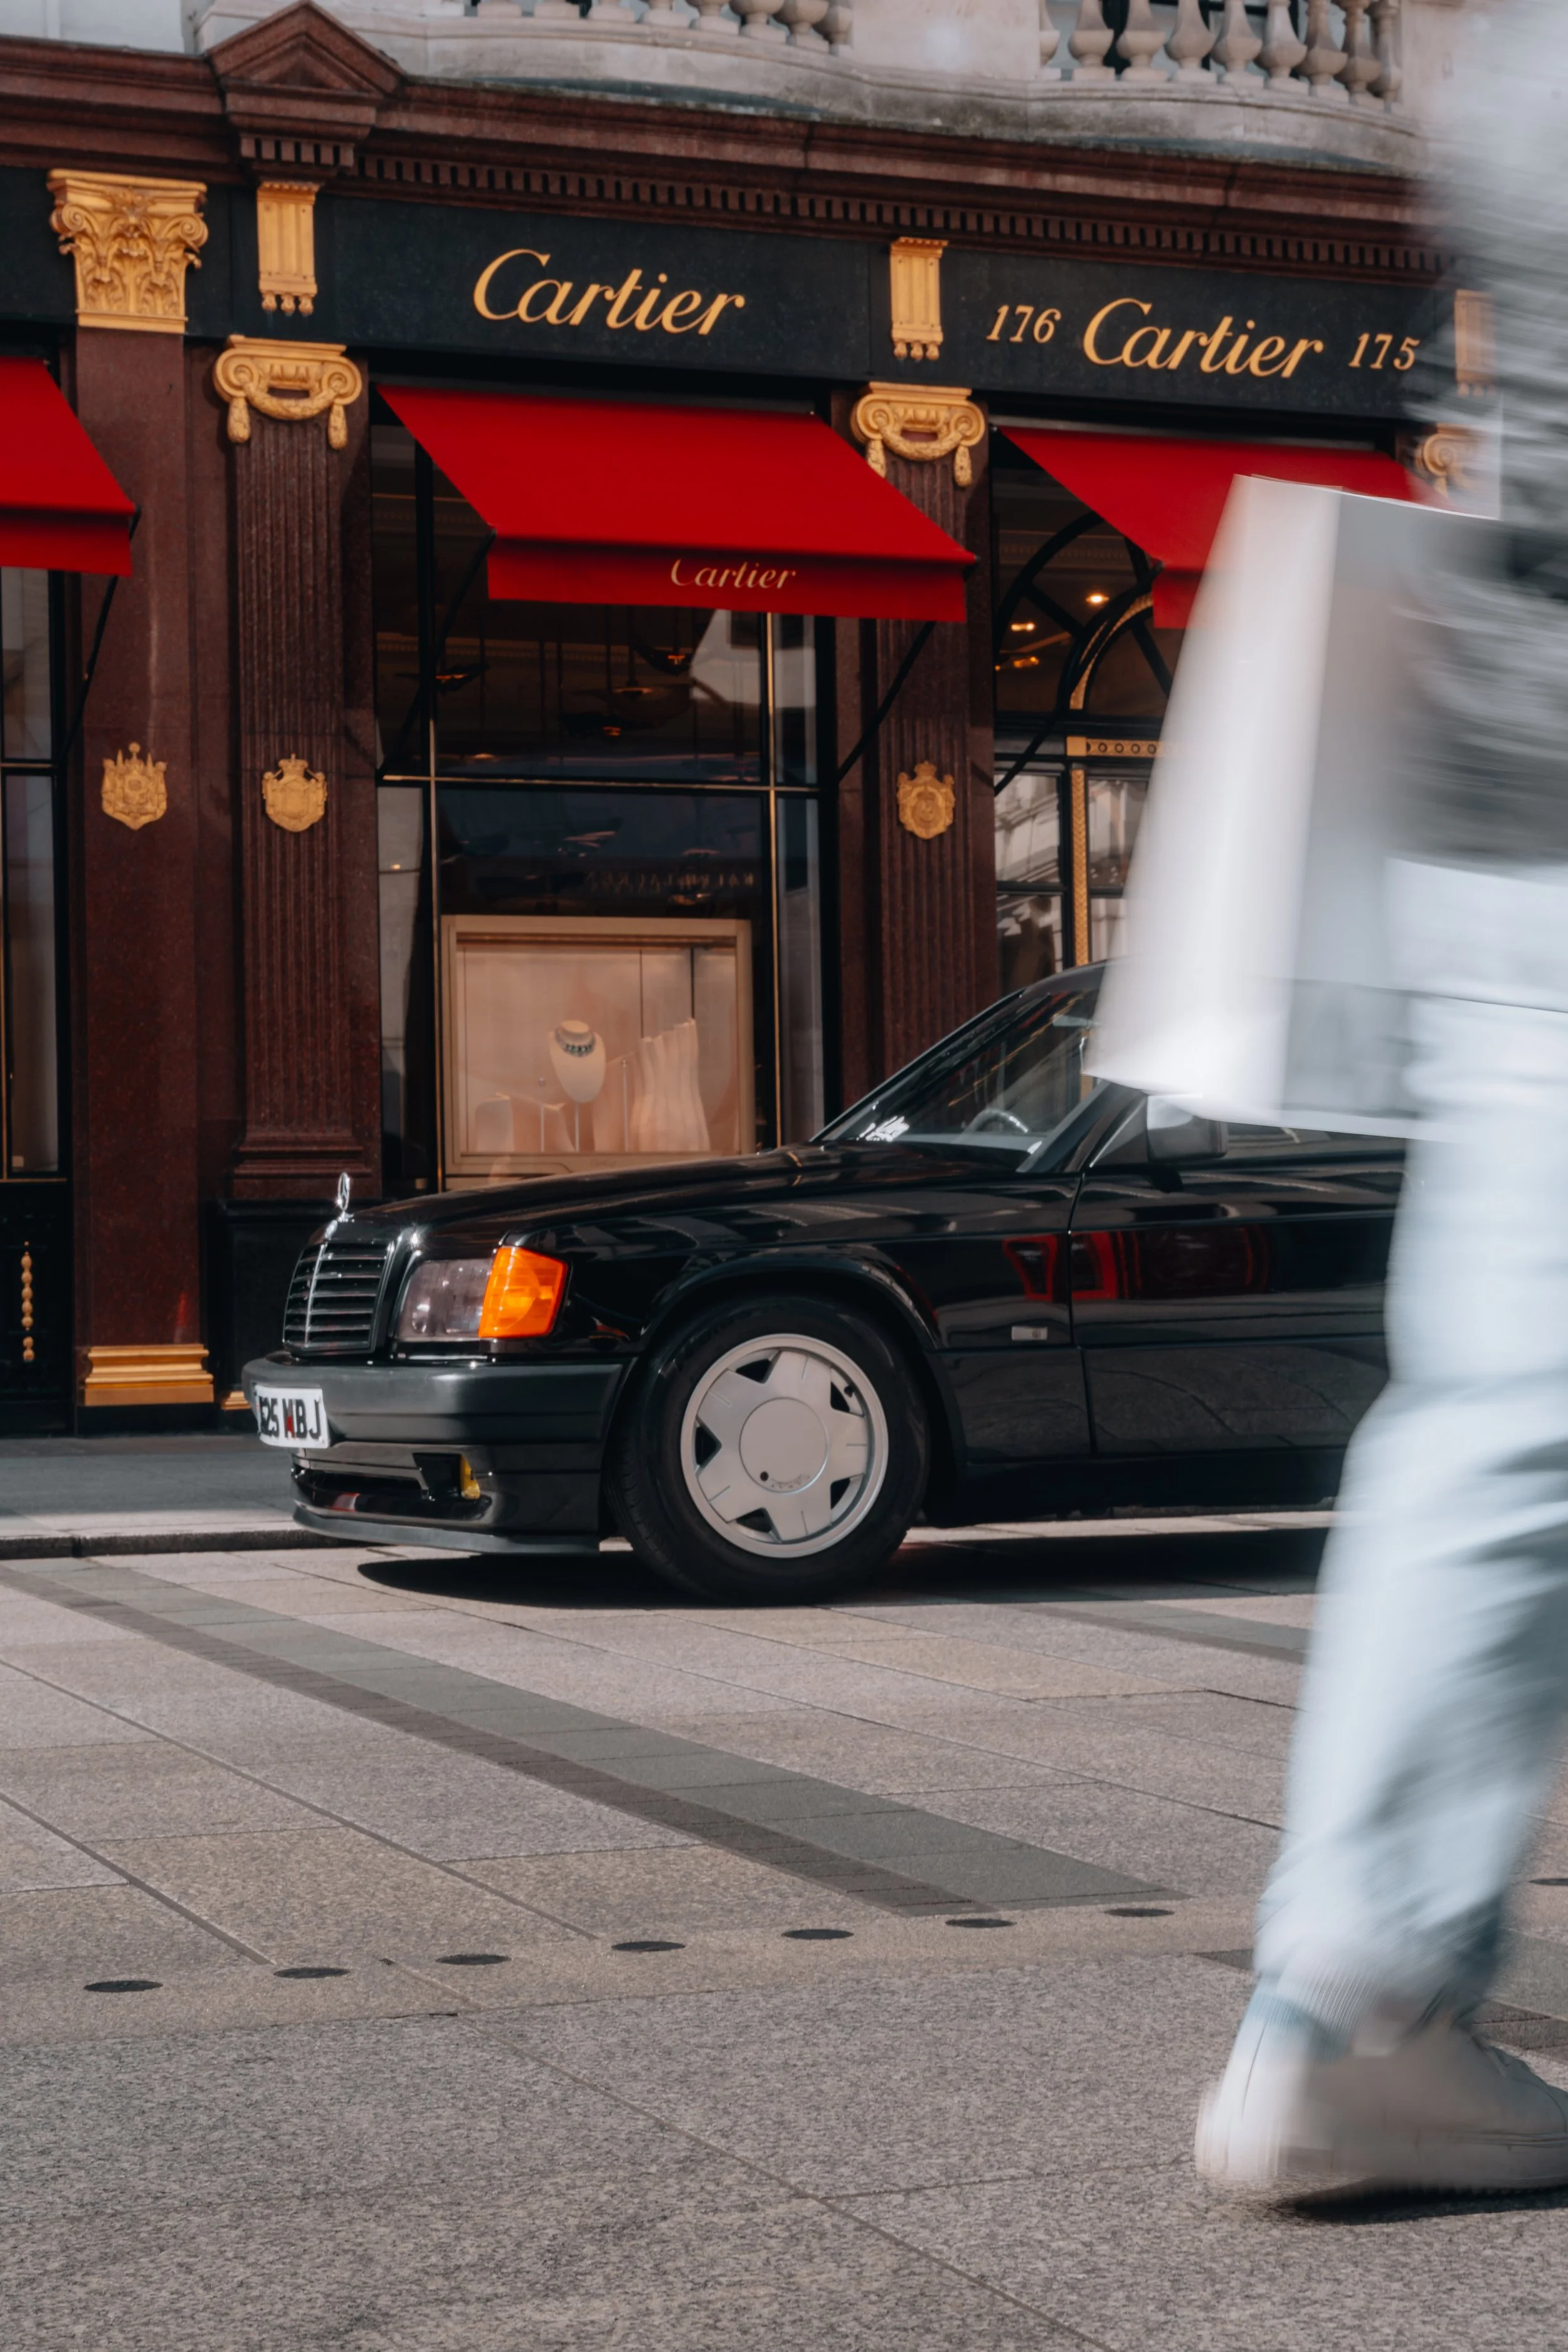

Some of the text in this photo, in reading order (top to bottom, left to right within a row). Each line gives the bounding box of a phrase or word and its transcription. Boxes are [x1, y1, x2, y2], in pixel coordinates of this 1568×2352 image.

[474, 248, 746, 335] Cartier
[986, 298, 1419, 378] 176 Cartier 175
